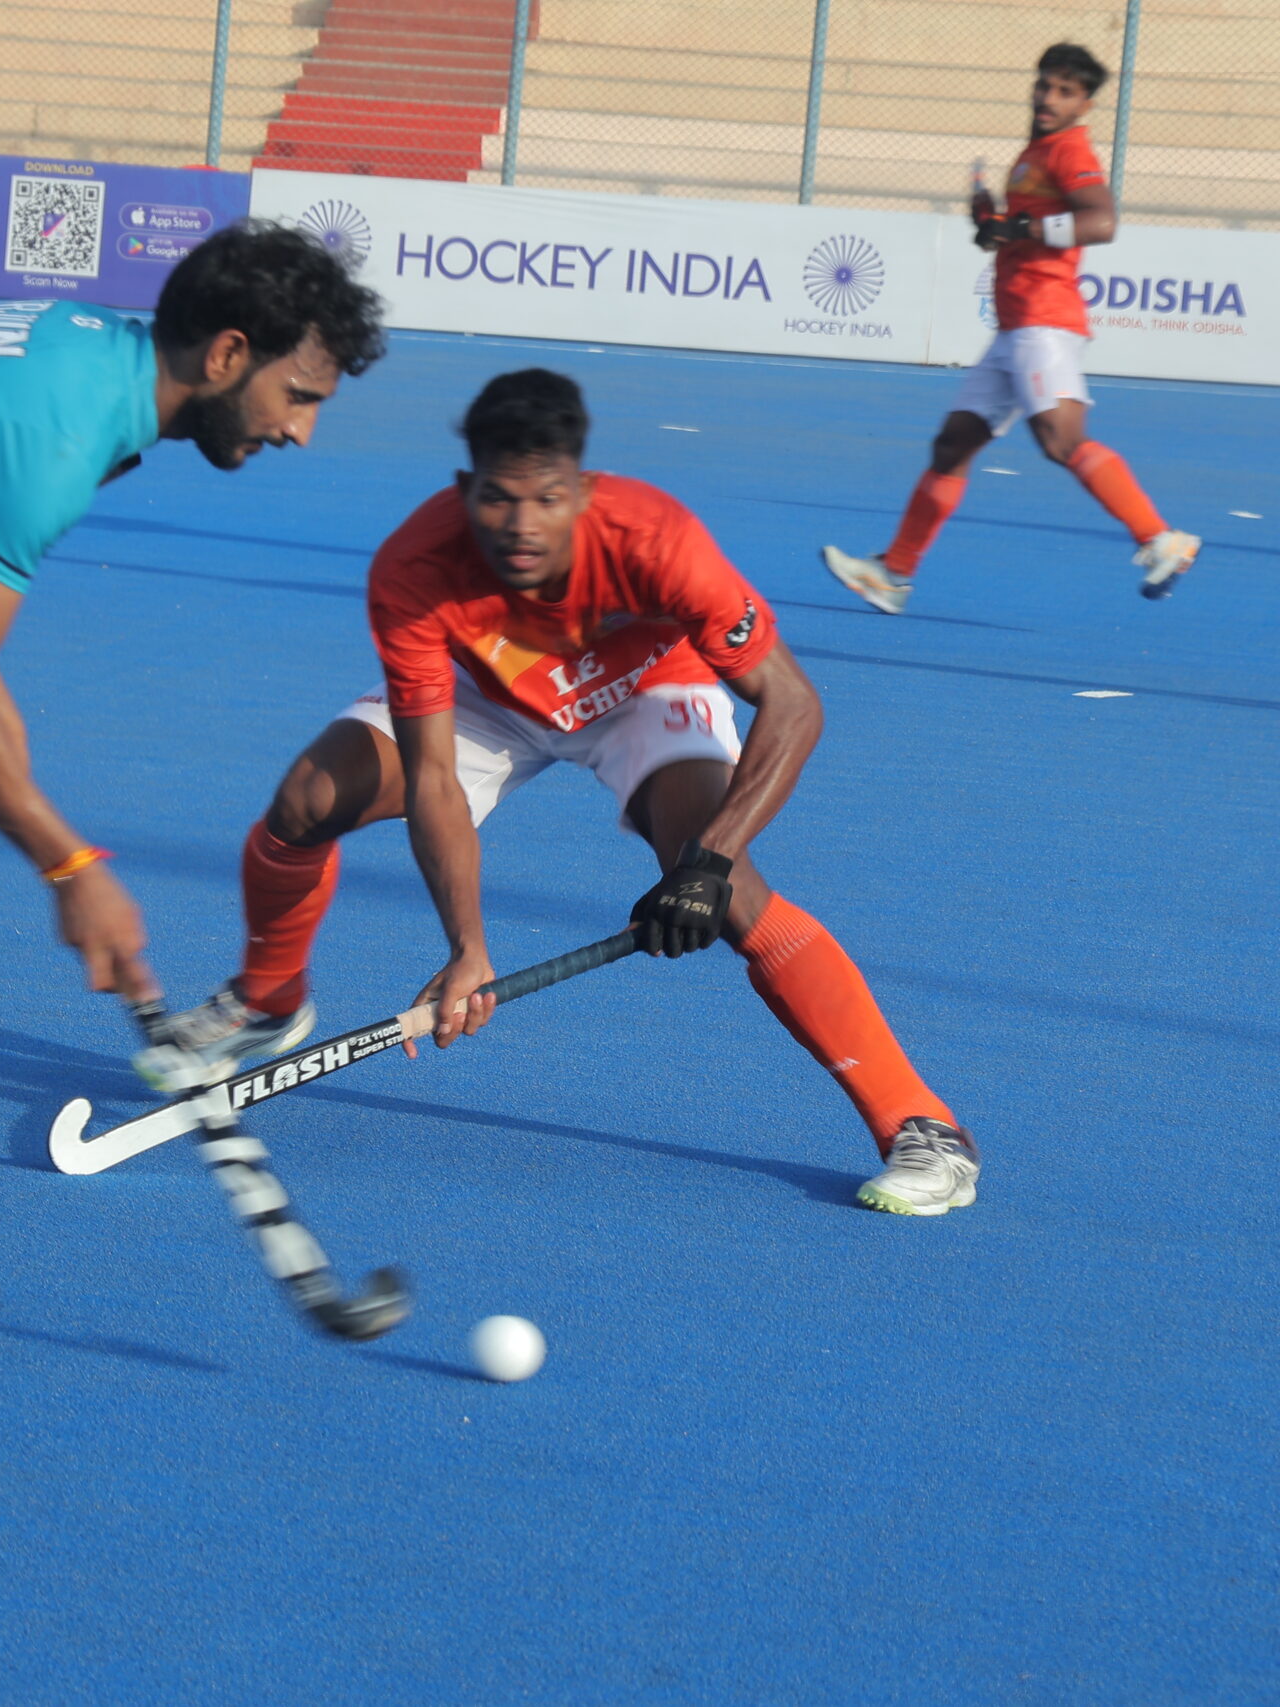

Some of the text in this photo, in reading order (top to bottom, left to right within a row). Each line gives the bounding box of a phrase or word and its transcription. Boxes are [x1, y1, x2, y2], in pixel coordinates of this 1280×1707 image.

[24, 161, 95, 176] DOWNLOAD
[149, 214, 202, 230] App Store
[146, 244, 179, 258] Google
[396, 232, 772, 302] HOCKEY INDIA
[22, 275, 79, 290] Scan Now
[1076, 273, 1247, 317] ODISHA
[784, 318, 893, 339] HOCKEY INDIA
[1151, 318, 1189, 332] THINK
[547, 650, 606, 697] LE
[352, 1041, 385, 1059] SUPER
[232, 1041, 350, 1110] FLASH
